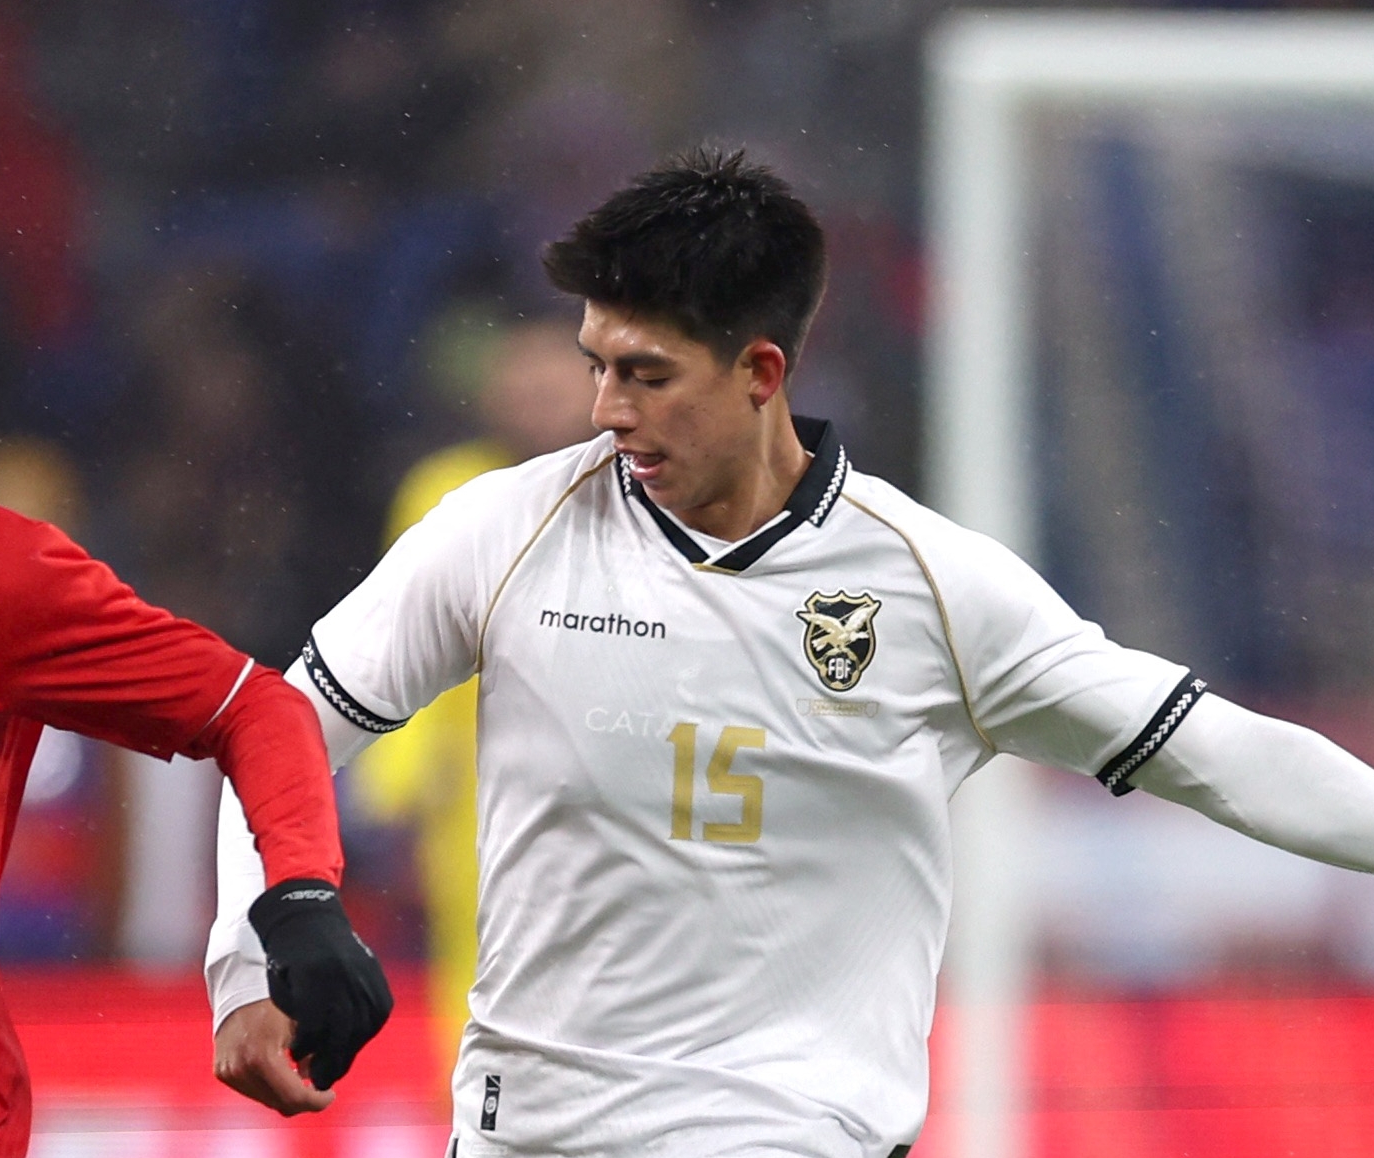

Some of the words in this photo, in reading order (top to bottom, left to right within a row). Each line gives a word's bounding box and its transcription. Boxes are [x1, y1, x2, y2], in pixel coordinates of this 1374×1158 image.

[539, 608, 667, 640] marathon
[828, 657, 854, 679] FBF
[665, 722, 767, 844] 15
